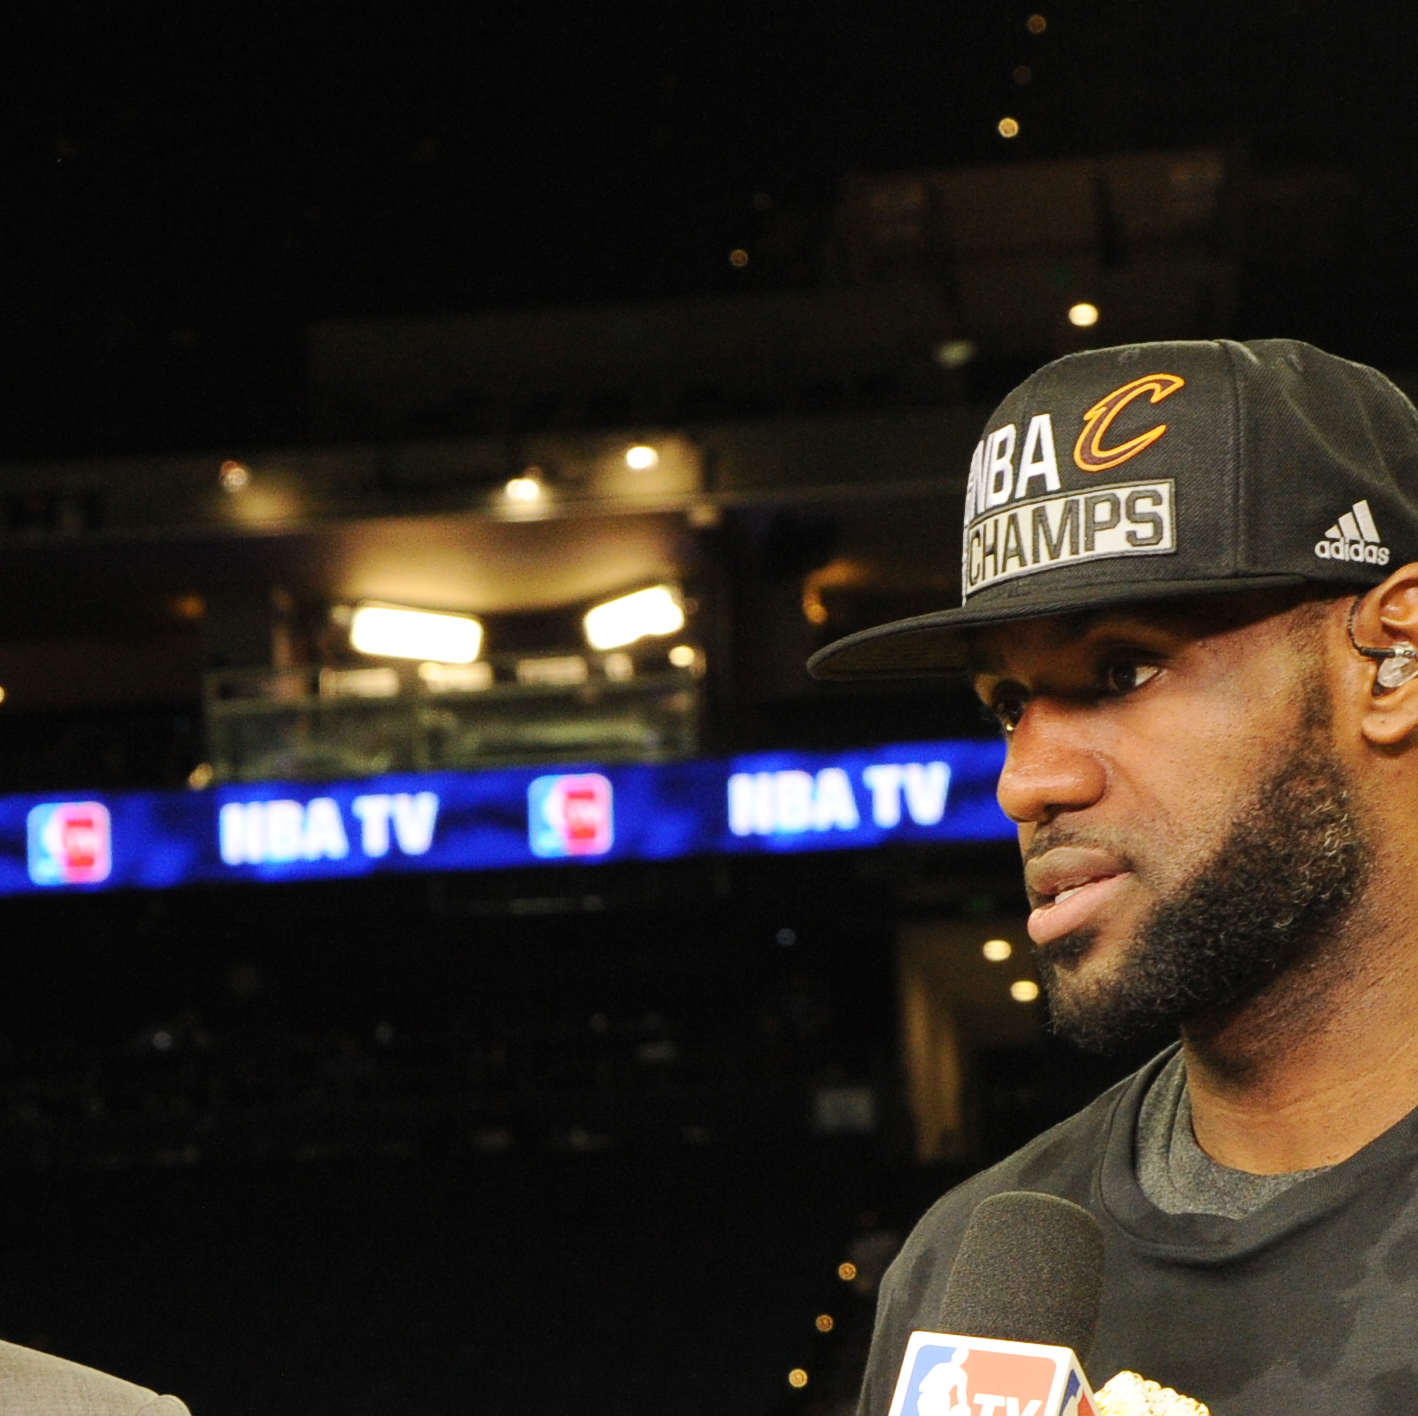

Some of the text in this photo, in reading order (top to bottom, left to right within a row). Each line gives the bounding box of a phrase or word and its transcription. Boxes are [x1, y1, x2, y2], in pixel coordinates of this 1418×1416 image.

[967, 413, 1061, 520] NBA
[968, 489, 1164, 588] CHAMPS
[1314, 537, 1390, 566] adidas
[219, 791, 439, 866] NBA TV
[728, 761, 951, 836] NBA TV
